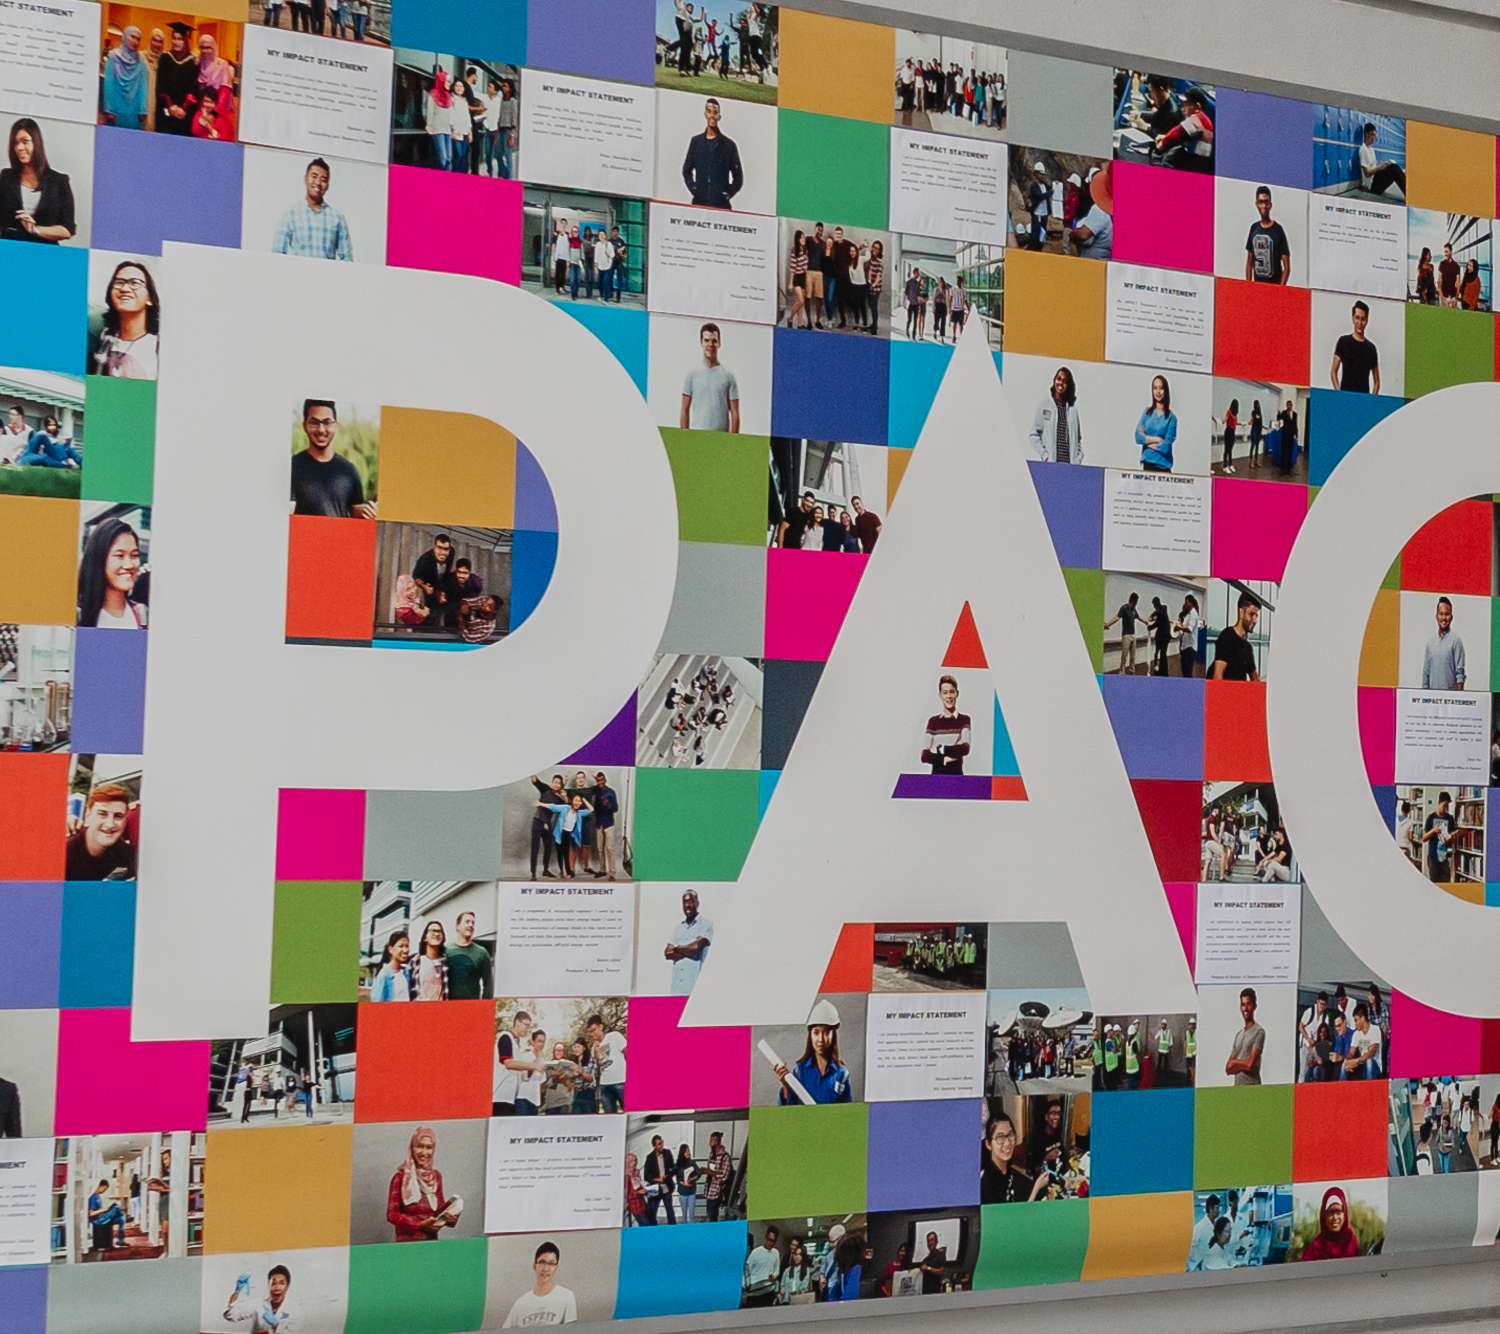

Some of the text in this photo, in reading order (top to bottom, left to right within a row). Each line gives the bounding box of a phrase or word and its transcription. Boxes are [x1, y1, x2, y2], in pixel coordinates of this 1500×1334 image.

[17, 2, 74, 17] STATEMENT
[267, 49, 368, 72] MY IMPACT STATEMENT
[542, 85, 633, 104] MY IMPACT STATEMENT
[921, 145, 947, 154] IMPACT
[949, 149, 989, 159] STATEMENT
[1335, 207, 1356, 215] IMPACT
[1358, 210, 1391, 219] STATEMENT
[683, 220, 711, 229] IMPACT
[713, 223, 757, 234] STATEMENT
[1135, 284, 1159, 292] IMPACT
[1160, 287, 1197, 297] STATEMENT
[1158, 476, 1194, 484] STATEMENT
[556, 1135, 603, 1143] STATEMENT
[522, 1311, 557, 1325] ESPRIT
